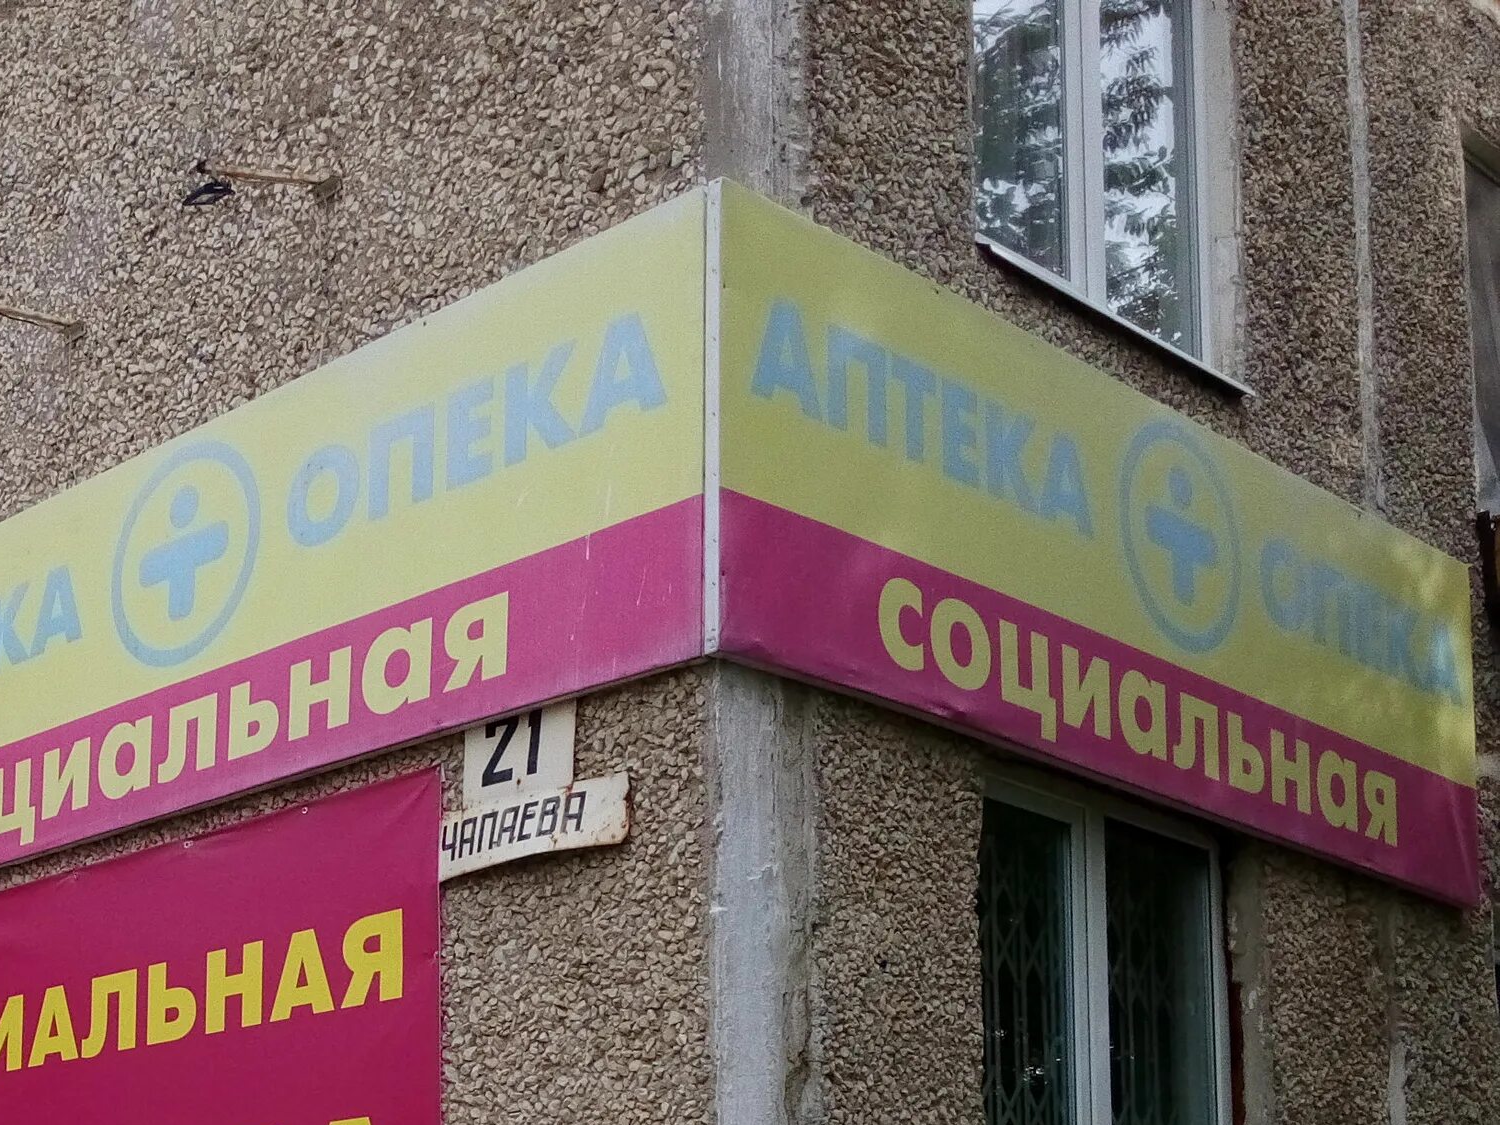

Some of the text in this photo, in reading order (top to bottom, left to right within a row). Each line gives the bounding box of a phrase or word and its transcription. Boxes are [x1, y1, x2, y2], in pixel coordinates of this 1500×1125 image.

[286, 312, 668, 548] ОПЕКА
[750, 298, 1467, 710] АПТЕКА ОПЕКА
[441, 791, 587, 862] ЧАПАЕВА
[481, 708, 543, 788] 21
[878, 577, 1399, 847] социальная
